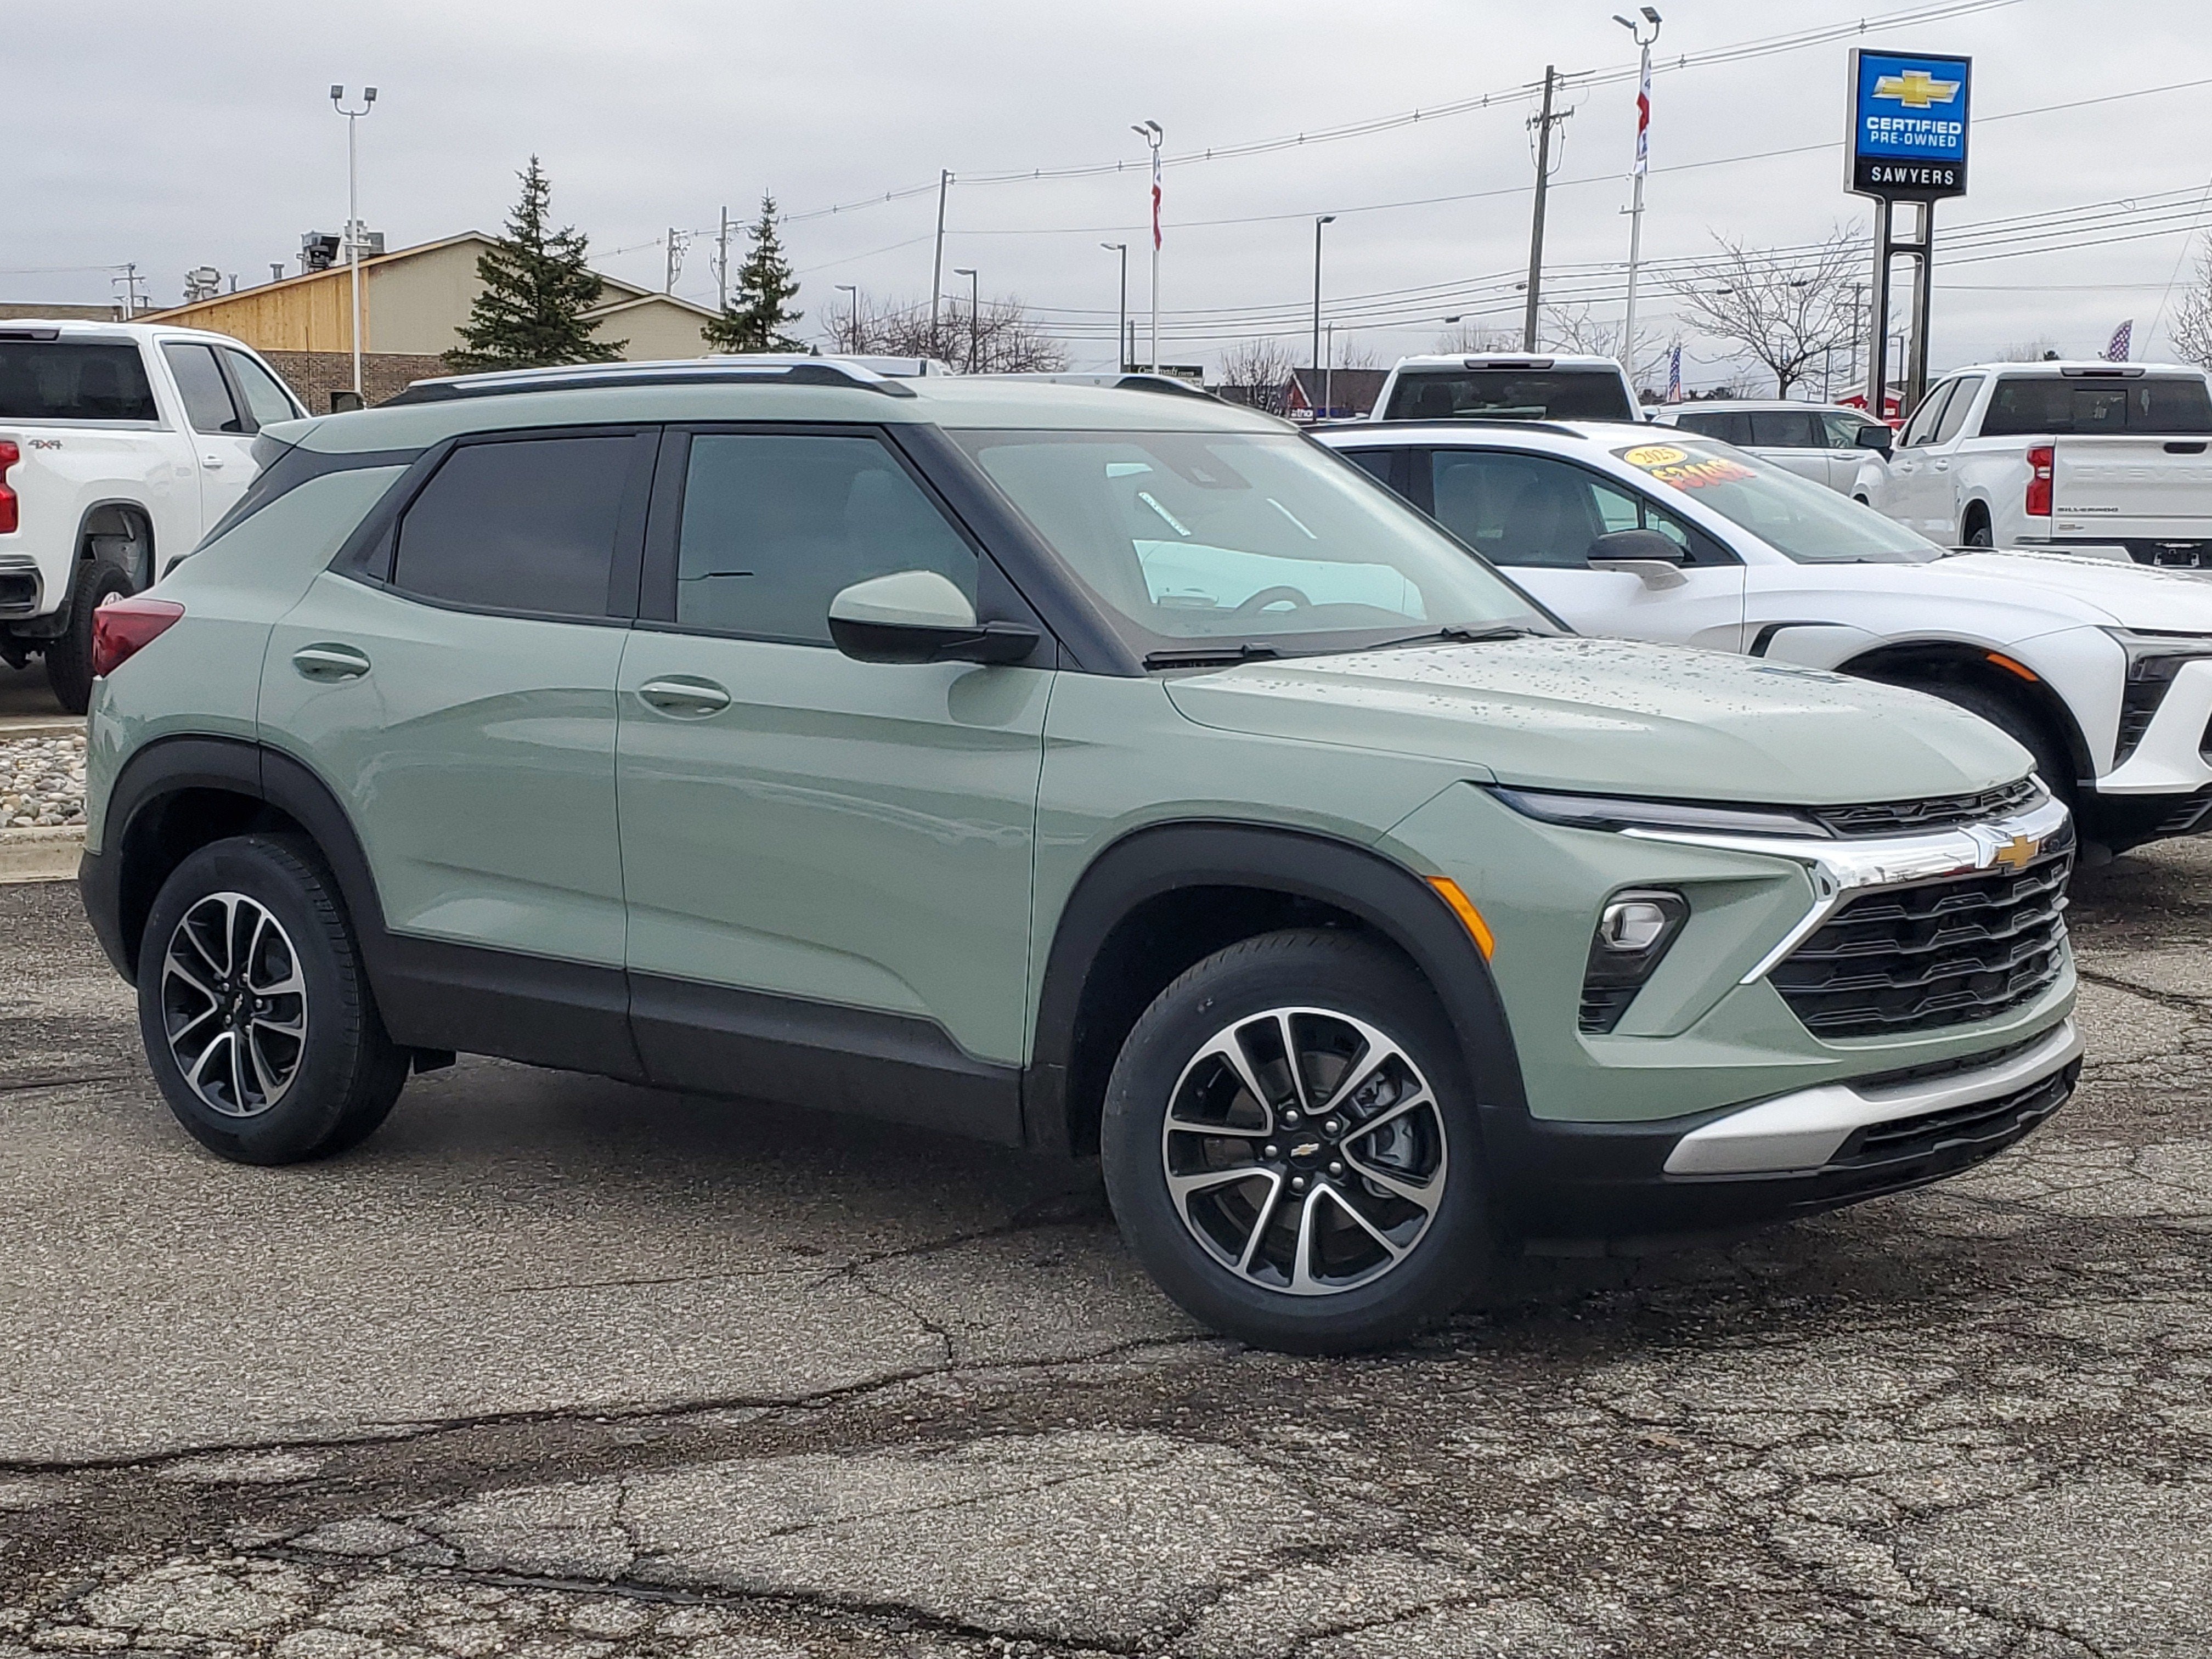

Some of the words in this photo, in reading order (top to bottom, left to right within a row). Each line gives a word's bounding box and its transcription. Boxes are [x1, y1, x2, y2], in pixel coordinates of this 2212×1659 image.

[1866, 117, 1962, 135] CERTIFIED
[1870, 131, 1956, 147] PRE-OWNED
[1871, 167, 1954, 185] SAWYERS
[1634, 448, 1677, 464] 2025
